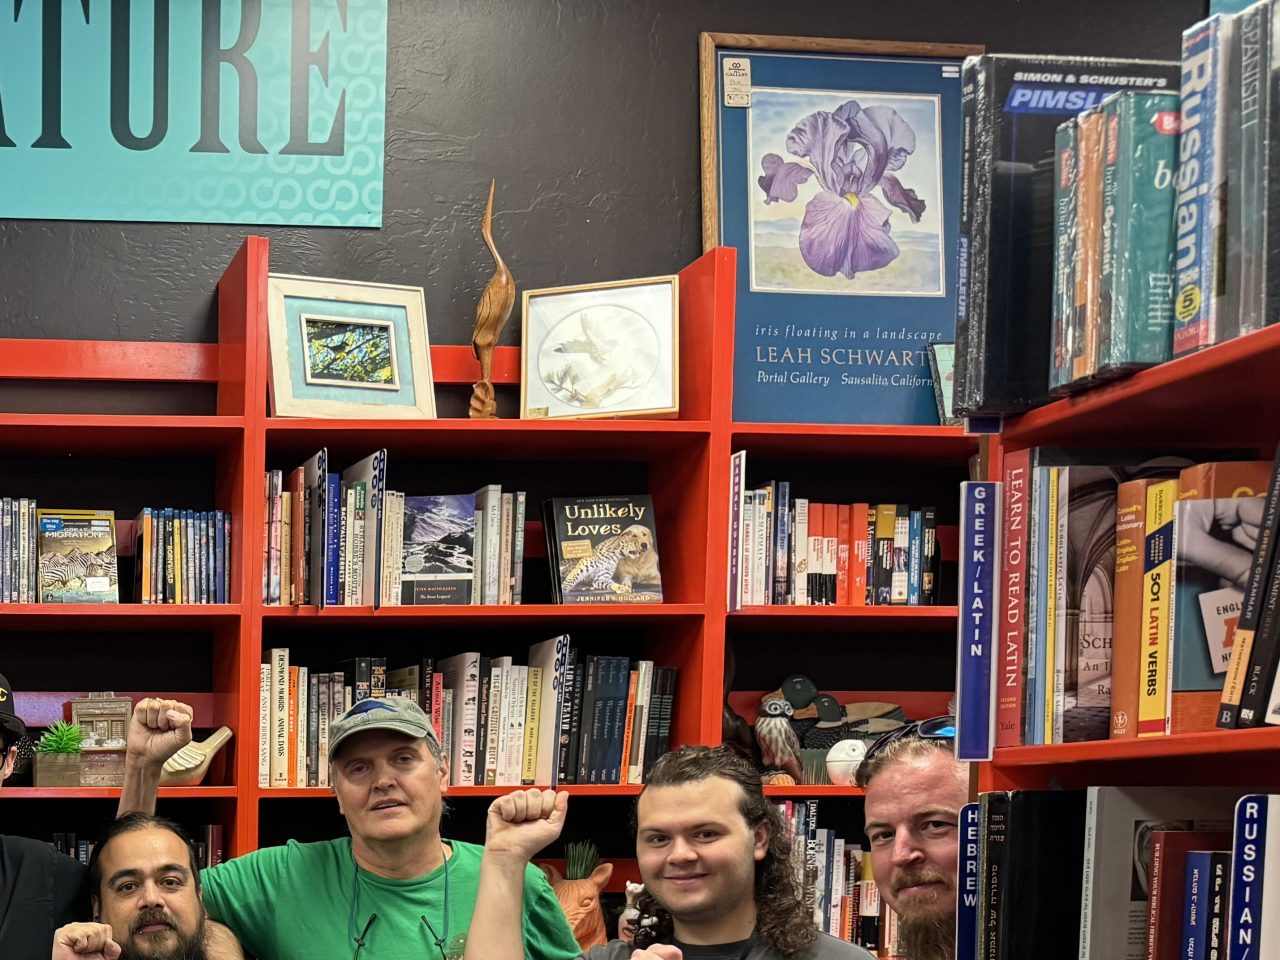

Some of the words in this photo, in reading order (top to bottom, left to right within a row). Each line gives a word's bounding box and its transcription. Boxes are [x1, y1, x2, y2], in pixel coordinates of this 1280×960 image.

[1013, 72, 1063, 83] SIMON
[1065, 74, 1076, 84] &
[1080, 75, 1168, 87] SCHUSTER'S
[1175, 52, 1213, 273] Russian
[755, 324, 779, 338] iris
[785, 324, 839, 342] floating
[844, 326, 858, 339] in
[862, 331, 870, 339] a
[876, 325, 943, 344] landscape
[756, 346, 813, 365] LEAH
[757, 370, 788, 384] Portal
[789, 371, 830, 388] Gallery
[840, 372, 889, 388] Sausalito,
[733, 457, 741, 511] MAMMAL
[1010, 467, 1024, 531] LEARN
[563, 503, 646, 521] Unlikely
[339, 506, 347, 552] BACKVALLEY
[566, 521, 622, 537] Loves
[757, 520, 766, 562] MAMMALS
[731, 521, 739, 575] GUIDES
[1009, 534, 1021, 566] TO
[338, 552, 346, 583] FERRETS
[970, 486, 988, 657] GREEK/LATIN
[1008, 568, 1021, 624] READ
[1149, 572, 1161, 605] 501
[1148, 606, 1160, 646] LATIN
[278, 654, 286, 686] DESMOND
[1005, 631, 1018, 688] LATIN
[1146, 650, 1158, 697] VERBS
[564, 664, 575, 692] LIONS
[277, 687, 285, 712] MORRIS
[262, 713, 268, 725] NO
[277, 717, 285, 740] ANIMAL
[561, 701, 572, 731] TSAVO
[277, 740, 285, 757] DAYS
[806, 803, 818, 831] DALTON
[963, 809, 979, 908] HEBREW
